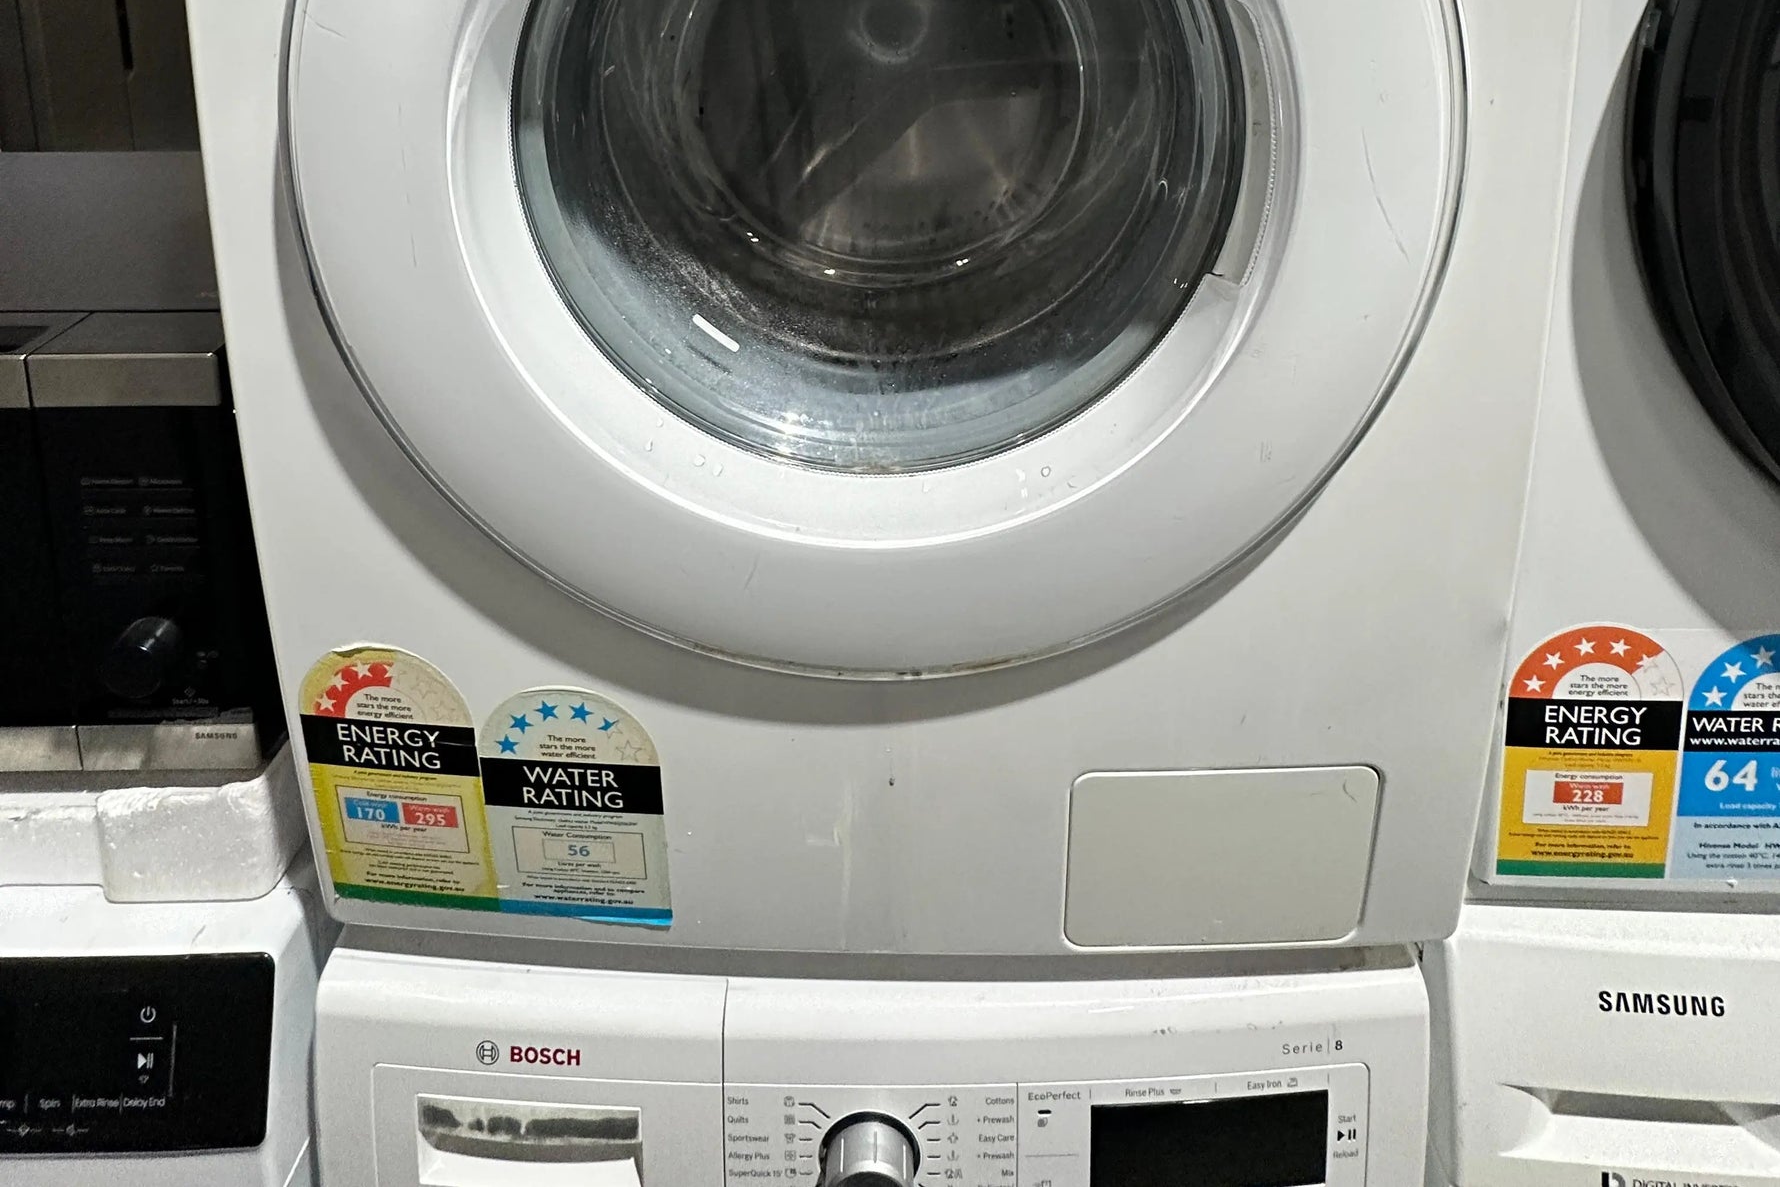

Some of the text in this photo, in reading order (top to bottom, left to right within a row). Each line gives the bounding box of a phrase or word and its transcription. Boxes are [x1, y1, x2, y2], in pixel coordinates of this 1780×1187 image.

[1580, 674, 1595, 682] The
[1755, 682, 1772, 690] The
[364, 693, 402, 703] The more
[356, 702, 412, 712] stars the more
[357, 710, 382, 719] energy
[1544, 705, 1648, 725] ENERGY
[1692, 717, 1765, 733] WATER
[195, 731, 238, 740] SAMSUNG
[336, 723, 441, 749] ENERGY
[547, 734, 562, 742] The
[1545, 725, 1643, 746] RATING
[560, 743, 573, 751] the
[342, 744, 441, 770] RATING
[522, 765, 619, 788] WATER
[1554, 772, 1578, 781] Energy
[1704, 759, 1759, 792] 64
[522, 787, 624, 809] RATING
[1571, 789, 1604, 803] 228
[356, 806, 386, 821] 170
[414, 811, 446, 826] 295
[542, 830, 613, 841] Water Consumption
[567, 844, 590, 857] 56
[1598, 990, 1726, 1018] SAMSUNG
[1281, 1039, 1343, 1056] Serie 8
[509, 1045, 581, 1066] BOSCH
[1247, 1078, 1282, 1092] Easy Iron
[1027, 1091, 1082, 1101] EcoPerfect
[1125, 1086, 1165, 1098] Rinse Plus
[39, 1098, 61, 1110] Spin
[123, 1096, 166, 1110] Delay End
[727, 1096, 749, 1105] Shirts
[985, 1097, 1015, 1106] Cottons
[727, 1115, 749, 1124] Quilts
[983, 1115, 1014, 1124] Prewash
[727, 1134, 769, 1143] Sportswear
[978, 1134, 1015, 1143] Easy Care
[728, 1151, 770, 1161] Allergy Plus
[983, 1151, 1014, 1160] Prewash
[728, 1169, 771, 1178] SuperQuick
